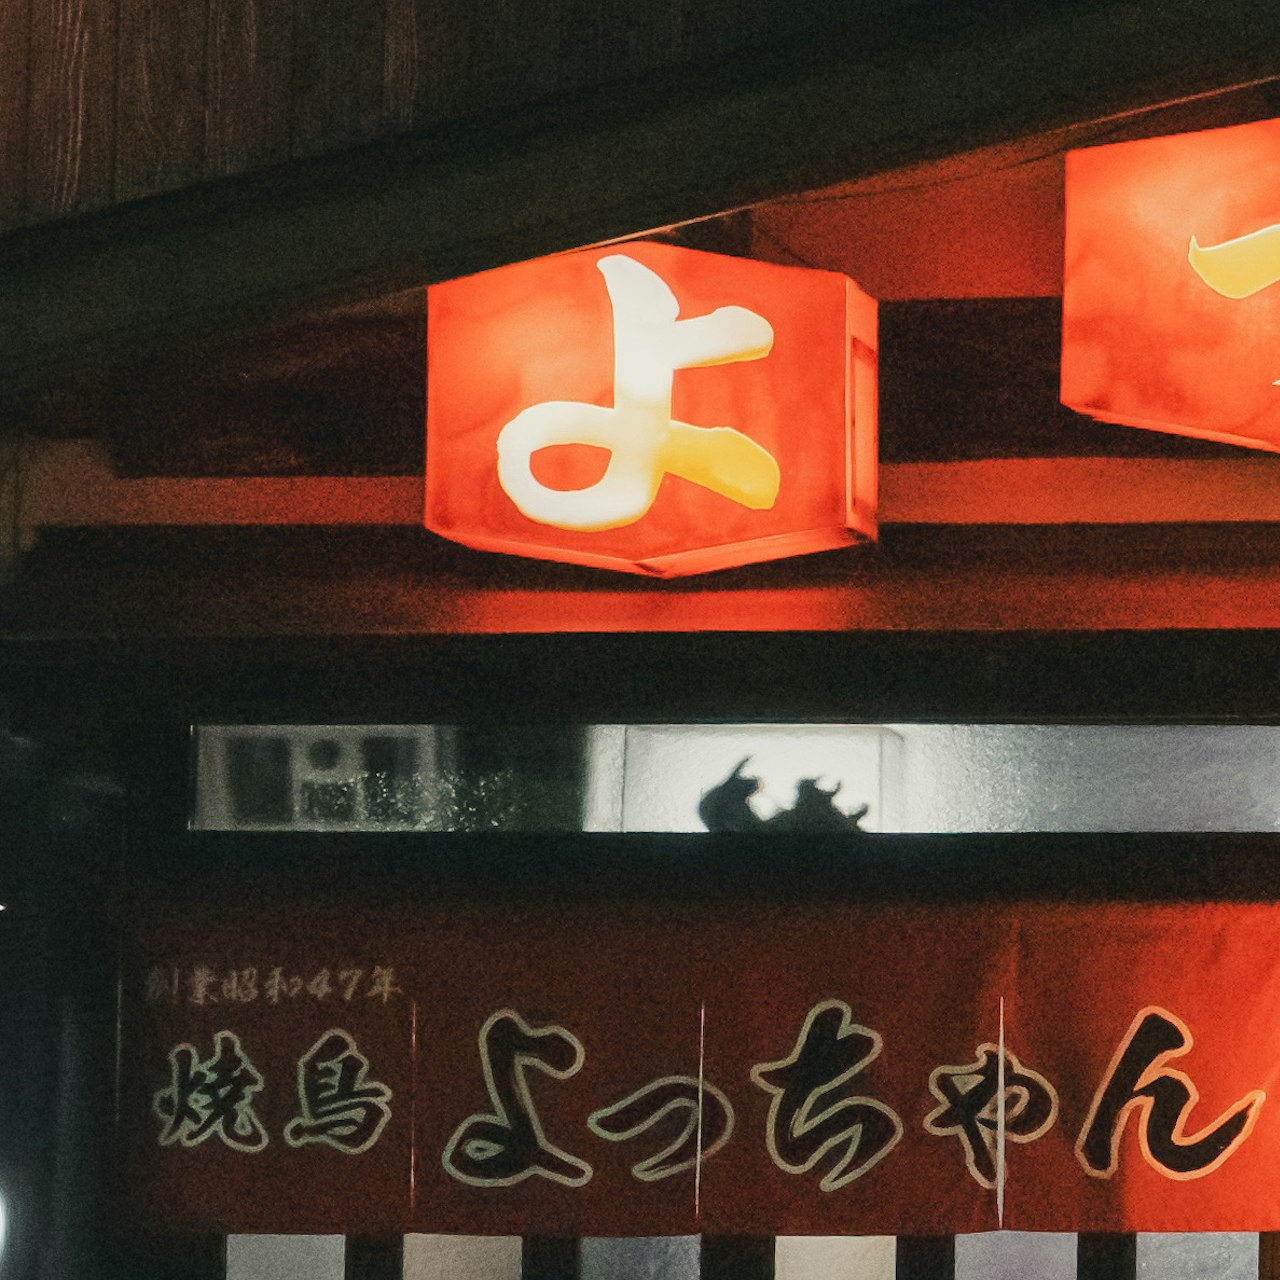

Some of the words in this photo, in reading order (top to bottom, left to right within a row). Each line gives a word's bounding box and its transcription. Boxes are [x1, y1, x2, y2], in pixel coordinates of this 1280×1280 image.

[494, 252, 781, 531] よ
[152, 1028, 394, 1155] 焼鳥
[442, 998, 1268, 1192] よっちゃん
